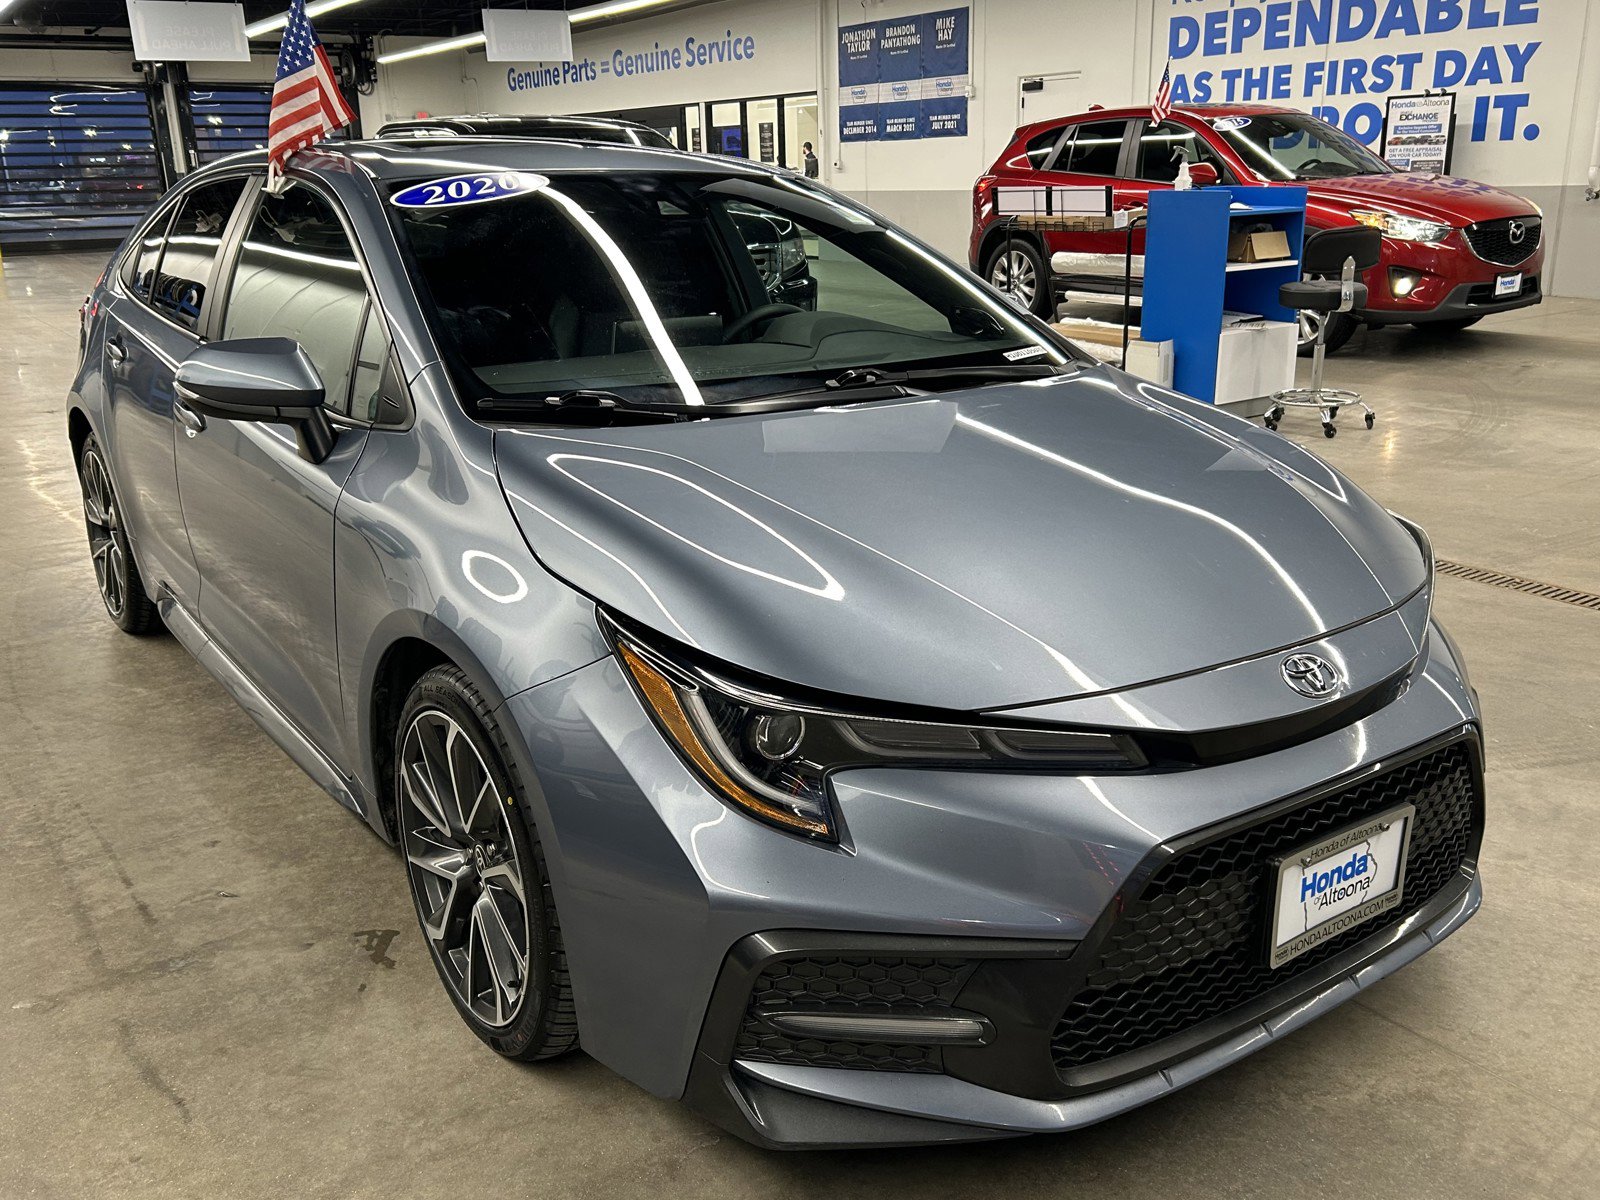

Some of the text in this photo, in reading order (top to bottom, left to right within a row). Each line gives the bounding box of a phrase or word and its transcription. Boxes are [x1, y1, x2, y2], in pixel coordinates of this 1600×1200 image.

[886, 24, 915, 37] BRANDON
[936, 16, 955, 30] MIKE
[841, 28, 876, 44] JONATHON
[881, 35, 920, 49] PANYATHONG
[938, 29, 953, 41] HAY
[847, 41, 870, 53] TAYLOR
[507, 29, 755, 92] Genuine Parts = Genuine Service
[1169, 42, 1542, 103] AS THE FIRST DAY
[886, 125, 902, 133] MARCH
[1471, 93, 1540, 142] IT.
[844, 126, 864, 134] DECEMBER
[422, 174, 520, 205] 2020
[1310, 823, 1383, 859] Honda of Altoona
[1300, 853, 1369, 903] Honda
[1318, 876, 1370, 910] Altoona
[1290, 899, 1384, 955] HONDAALTOONA.COM
